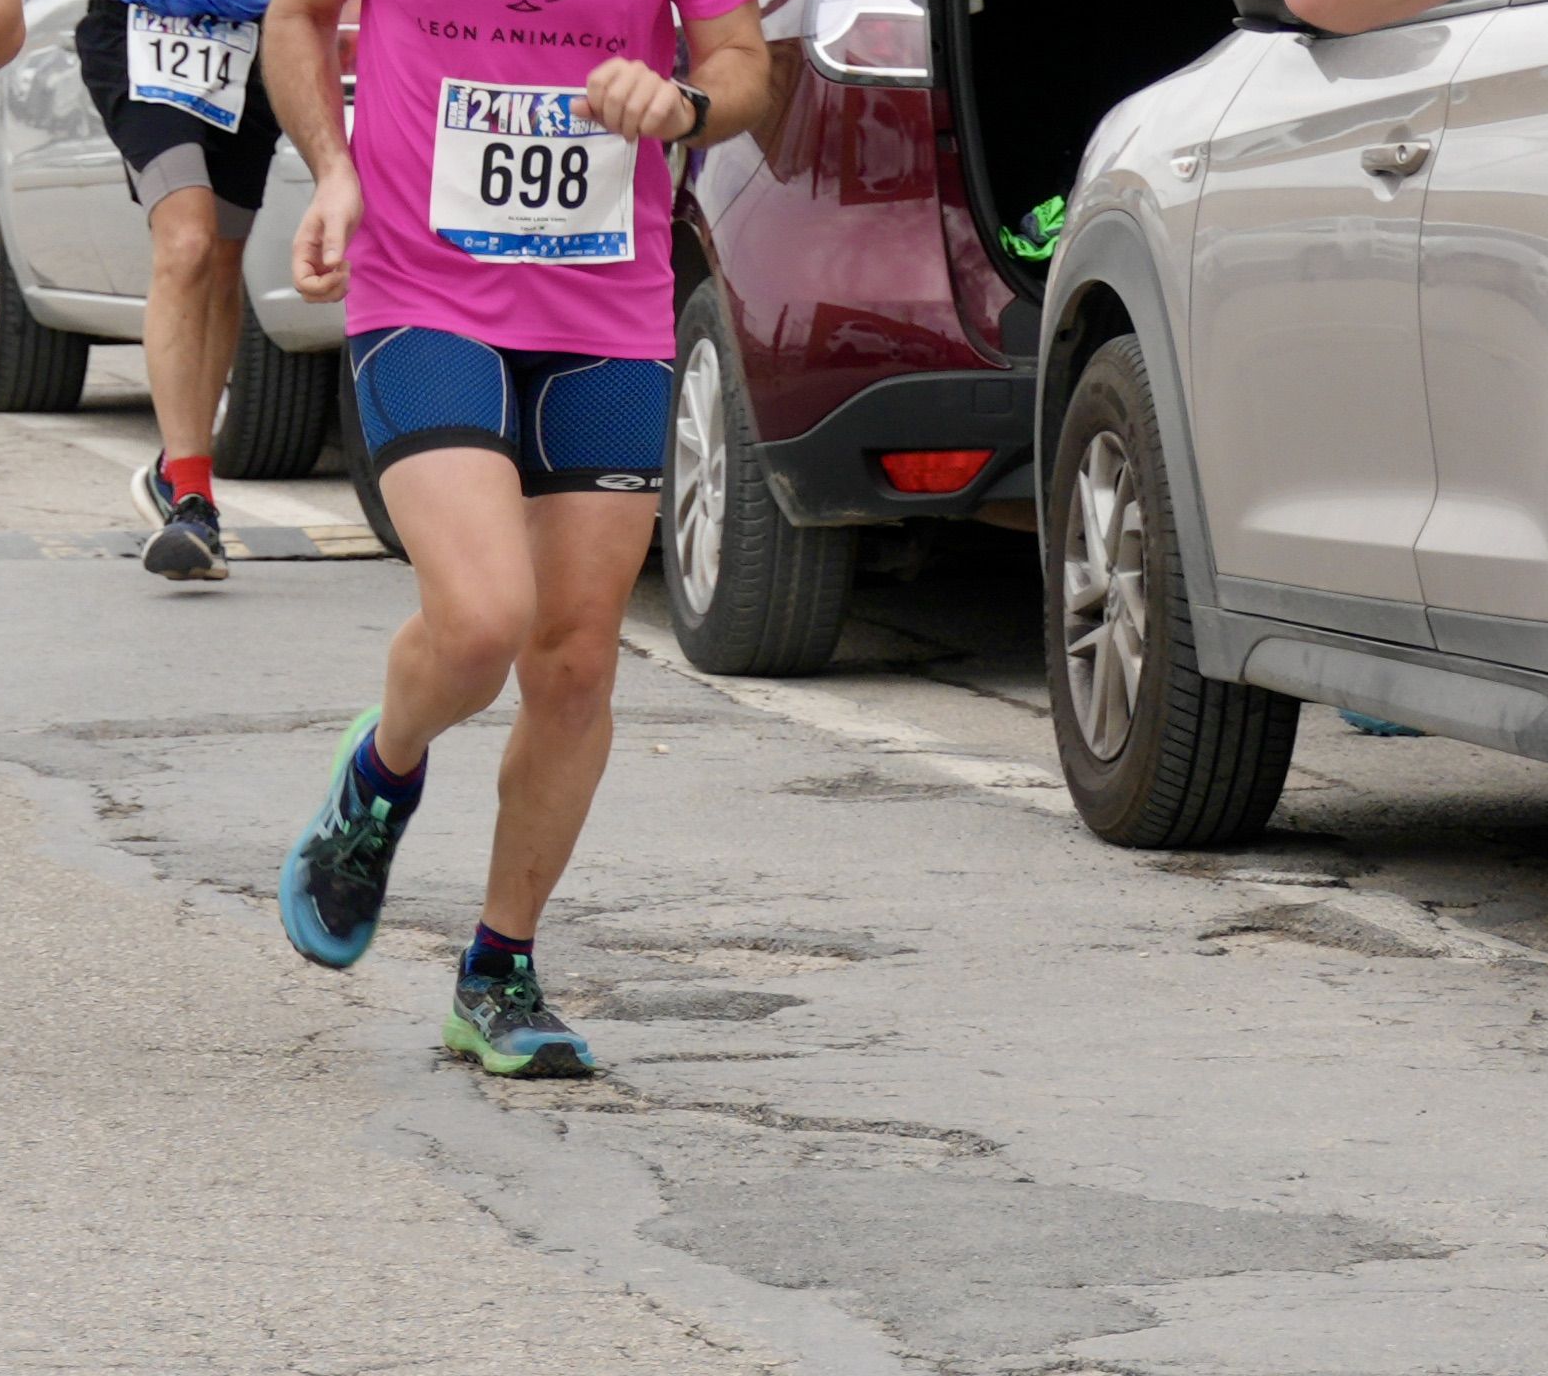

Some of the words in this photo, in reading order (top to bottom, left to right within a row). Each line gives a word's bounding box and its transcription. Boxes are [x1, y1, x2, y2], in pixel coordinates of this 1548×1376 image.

[418, 18, 477, 40] LEÓN
[149, 39, 232, 90] 1214
[470, 90, 533, 134] 21K
[480, 142, 590, 209] 698
